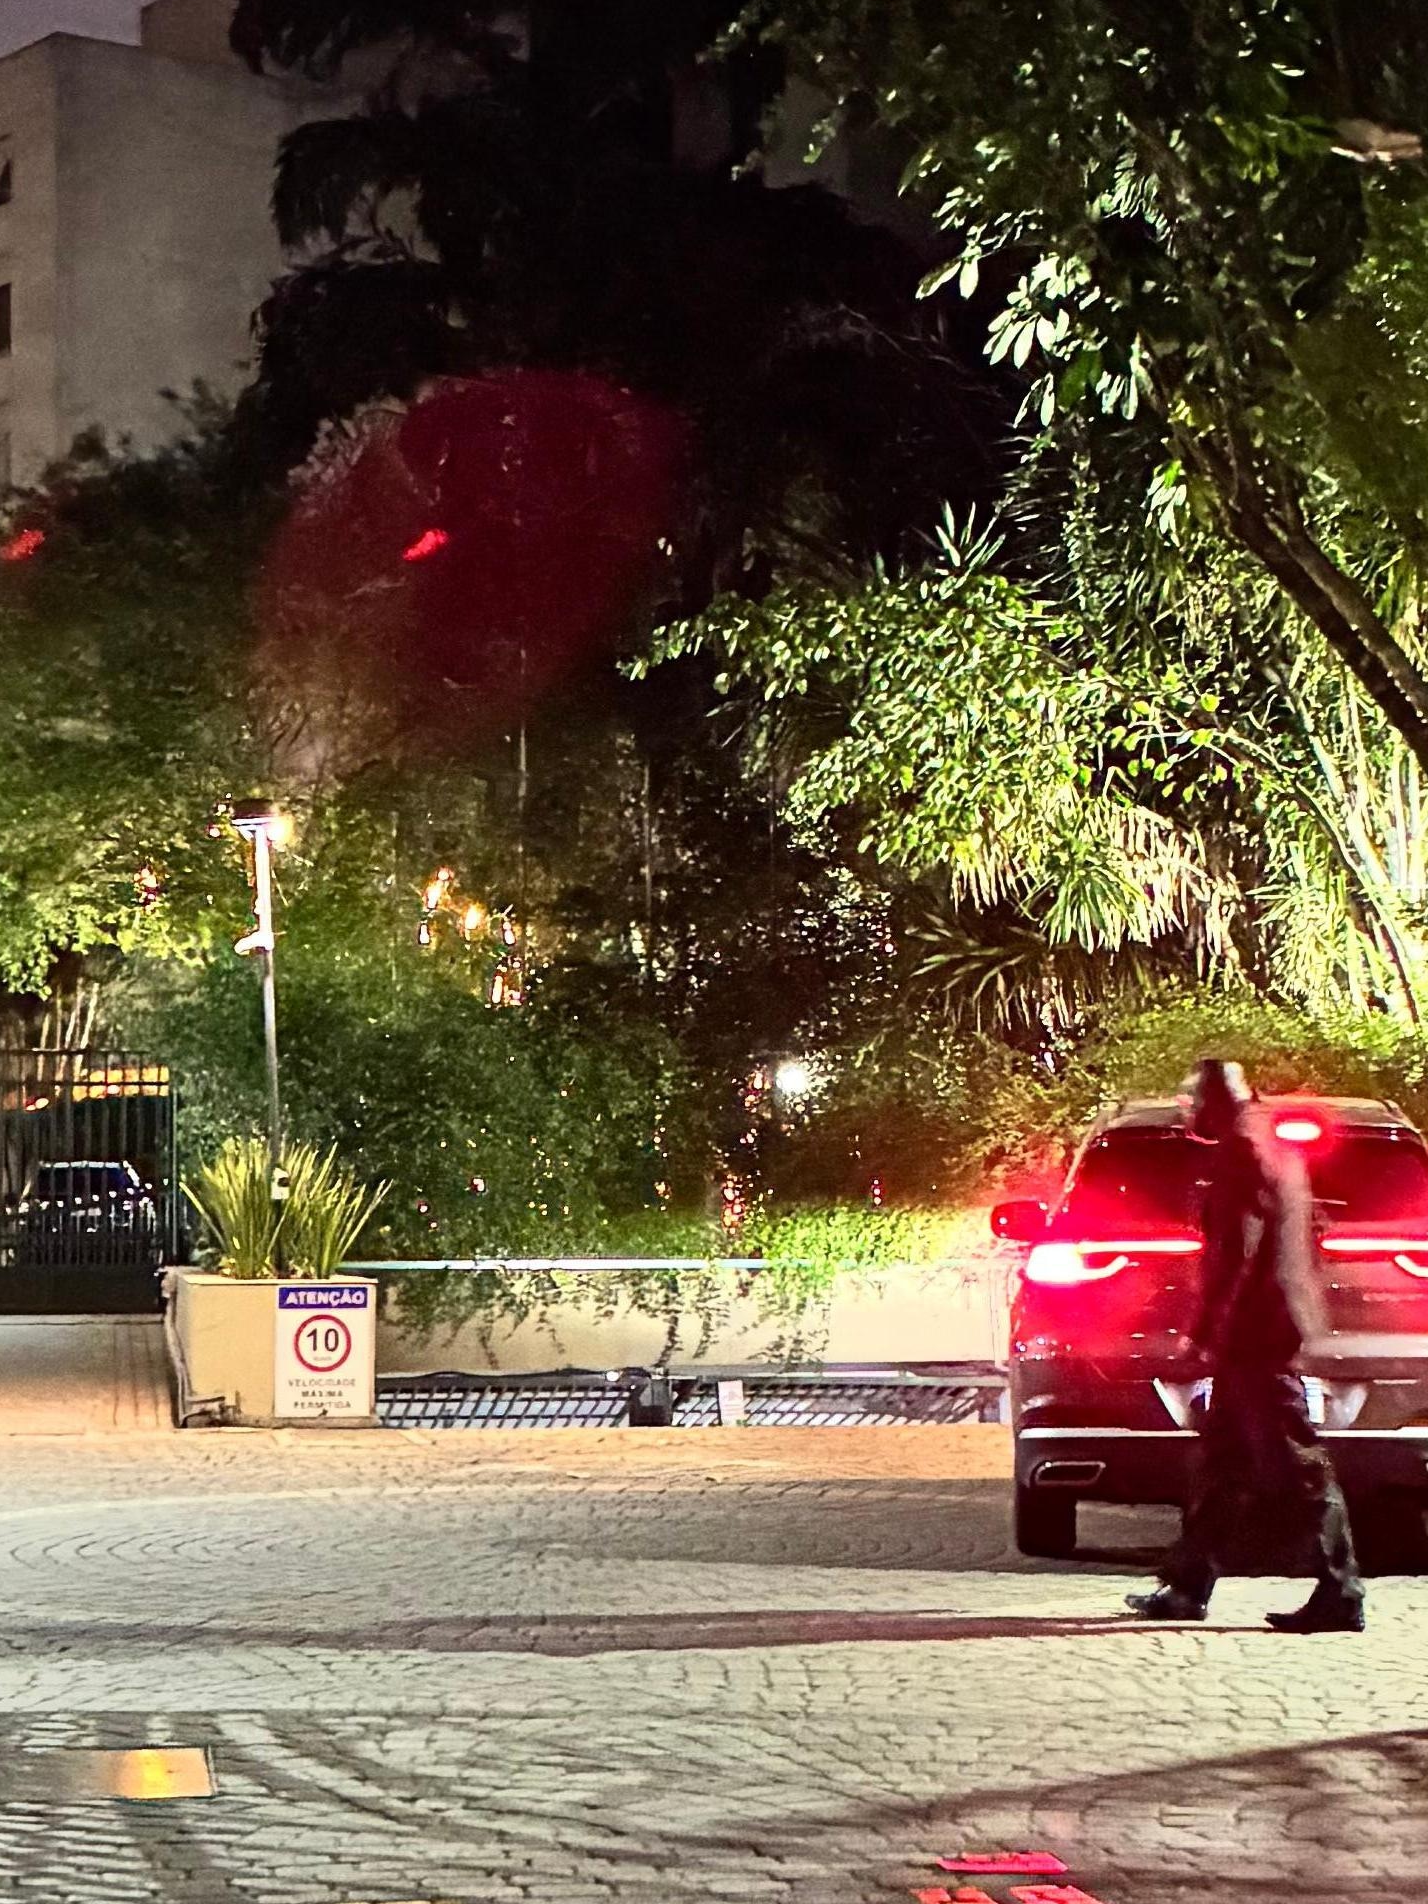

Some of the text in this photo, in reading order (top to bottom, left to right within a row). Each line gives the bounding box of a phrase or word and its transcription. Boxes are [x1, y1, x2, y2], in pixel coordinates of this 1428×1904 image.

[286, 1289, 365, 1306] ATENÇÃO
[306, 1327, 340, 1353] 10
[288, 1379, 356, 1387] VELOCIDADE
